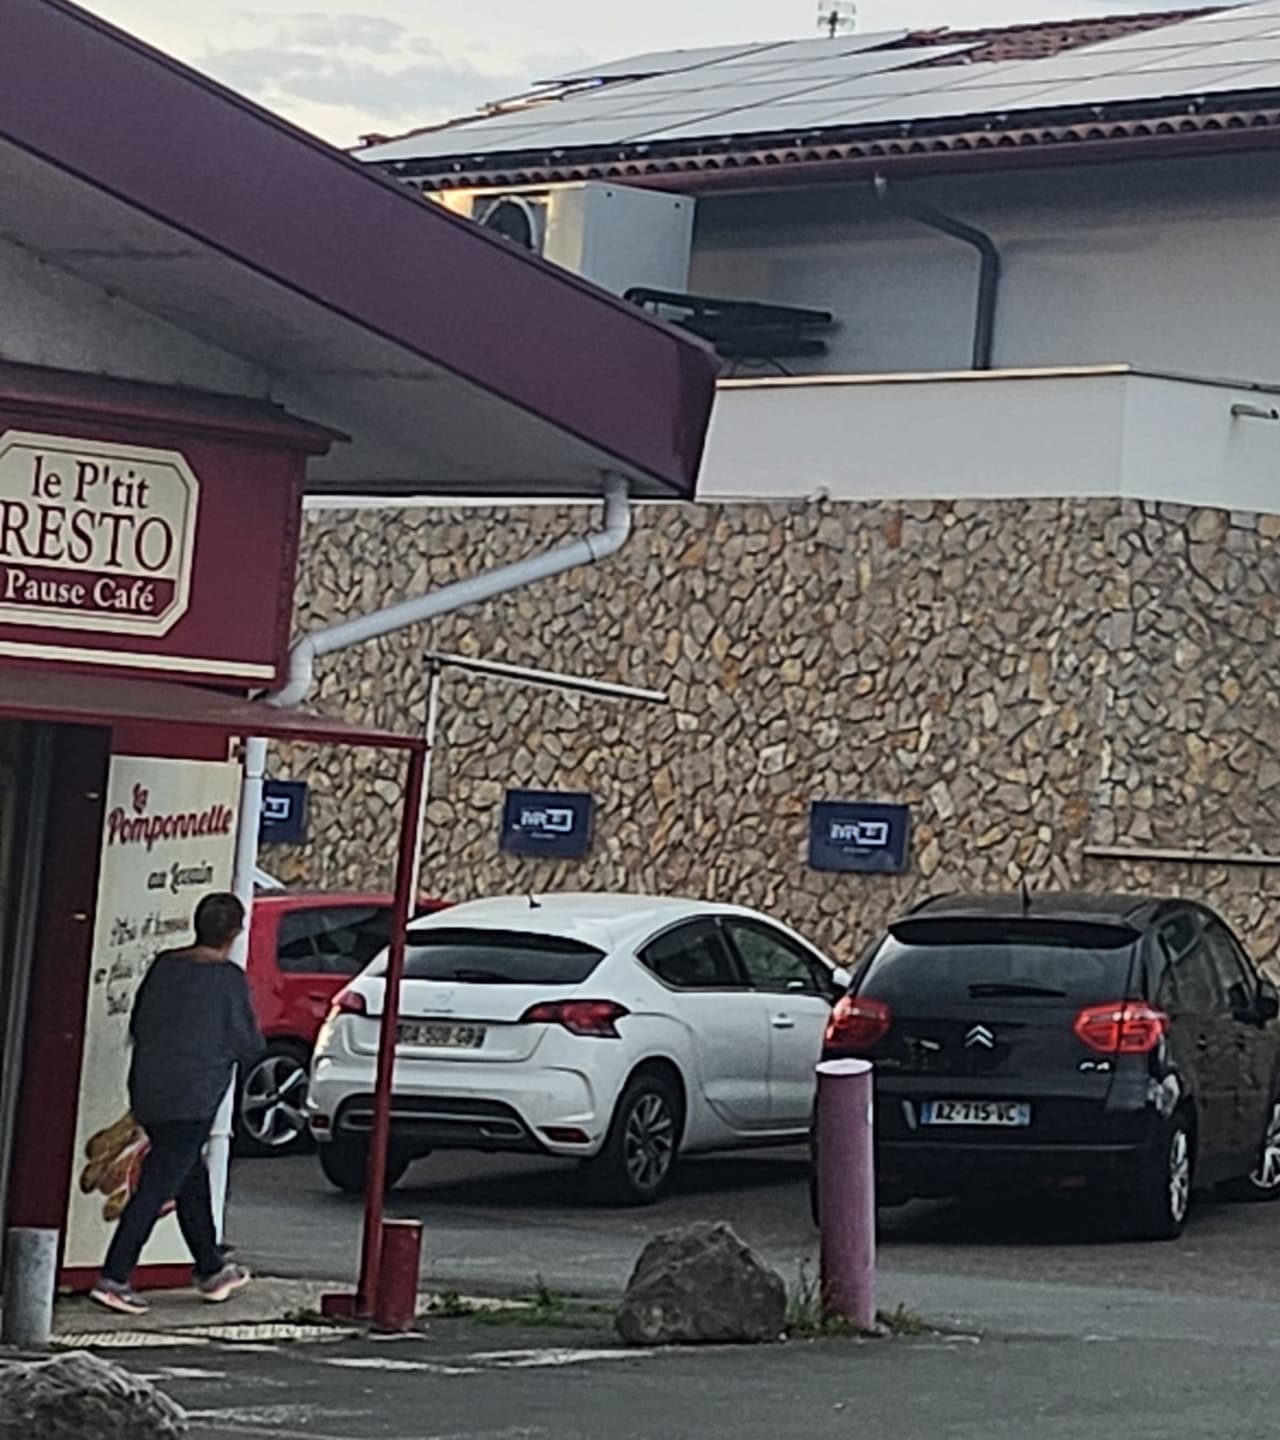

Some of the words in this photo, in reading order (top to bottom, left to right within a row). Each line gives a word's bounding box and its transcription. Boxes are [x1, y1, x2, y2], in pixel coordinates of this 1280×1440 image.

[31, 455, 62, 499] le
[73, 459, 150, 509] P'tit
[0, 499, 173, 572] RESTO
[5, 567, 86, 605] Pause
[93, 577, 155, 611] Café
